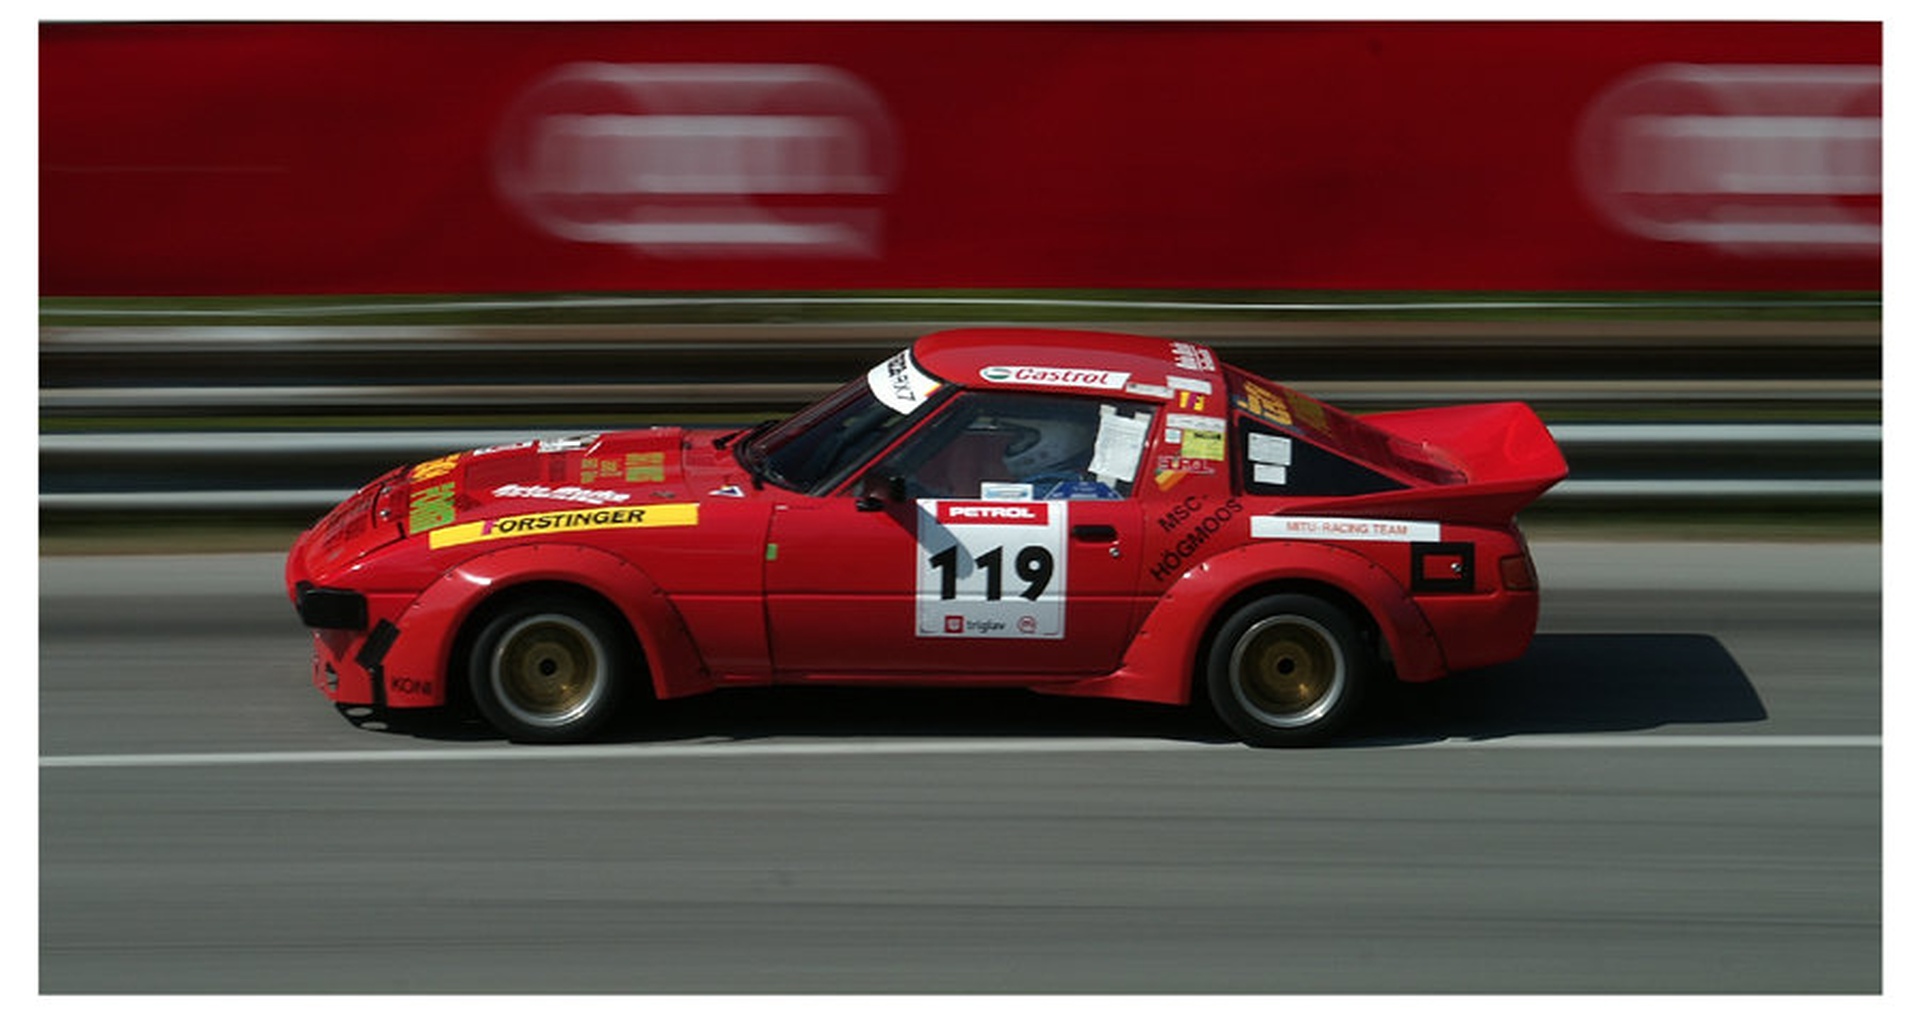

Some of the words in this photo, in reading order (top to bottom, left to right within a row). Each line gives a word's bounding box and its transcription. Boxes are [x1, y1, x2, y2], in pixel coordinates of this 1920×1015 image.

[1014, 368, 1109, 385] Castrol
[949, 505, 1036, 519] PETROL
[481, 508, 646, 536] FORSTINGER
[1373, 524, 1408, 535] TEAM
[1150, 498, 1243, 581] HÖGMOOS
[929, 545, 1054, 601] 119
[966, 617, 1006, 634] triglav
